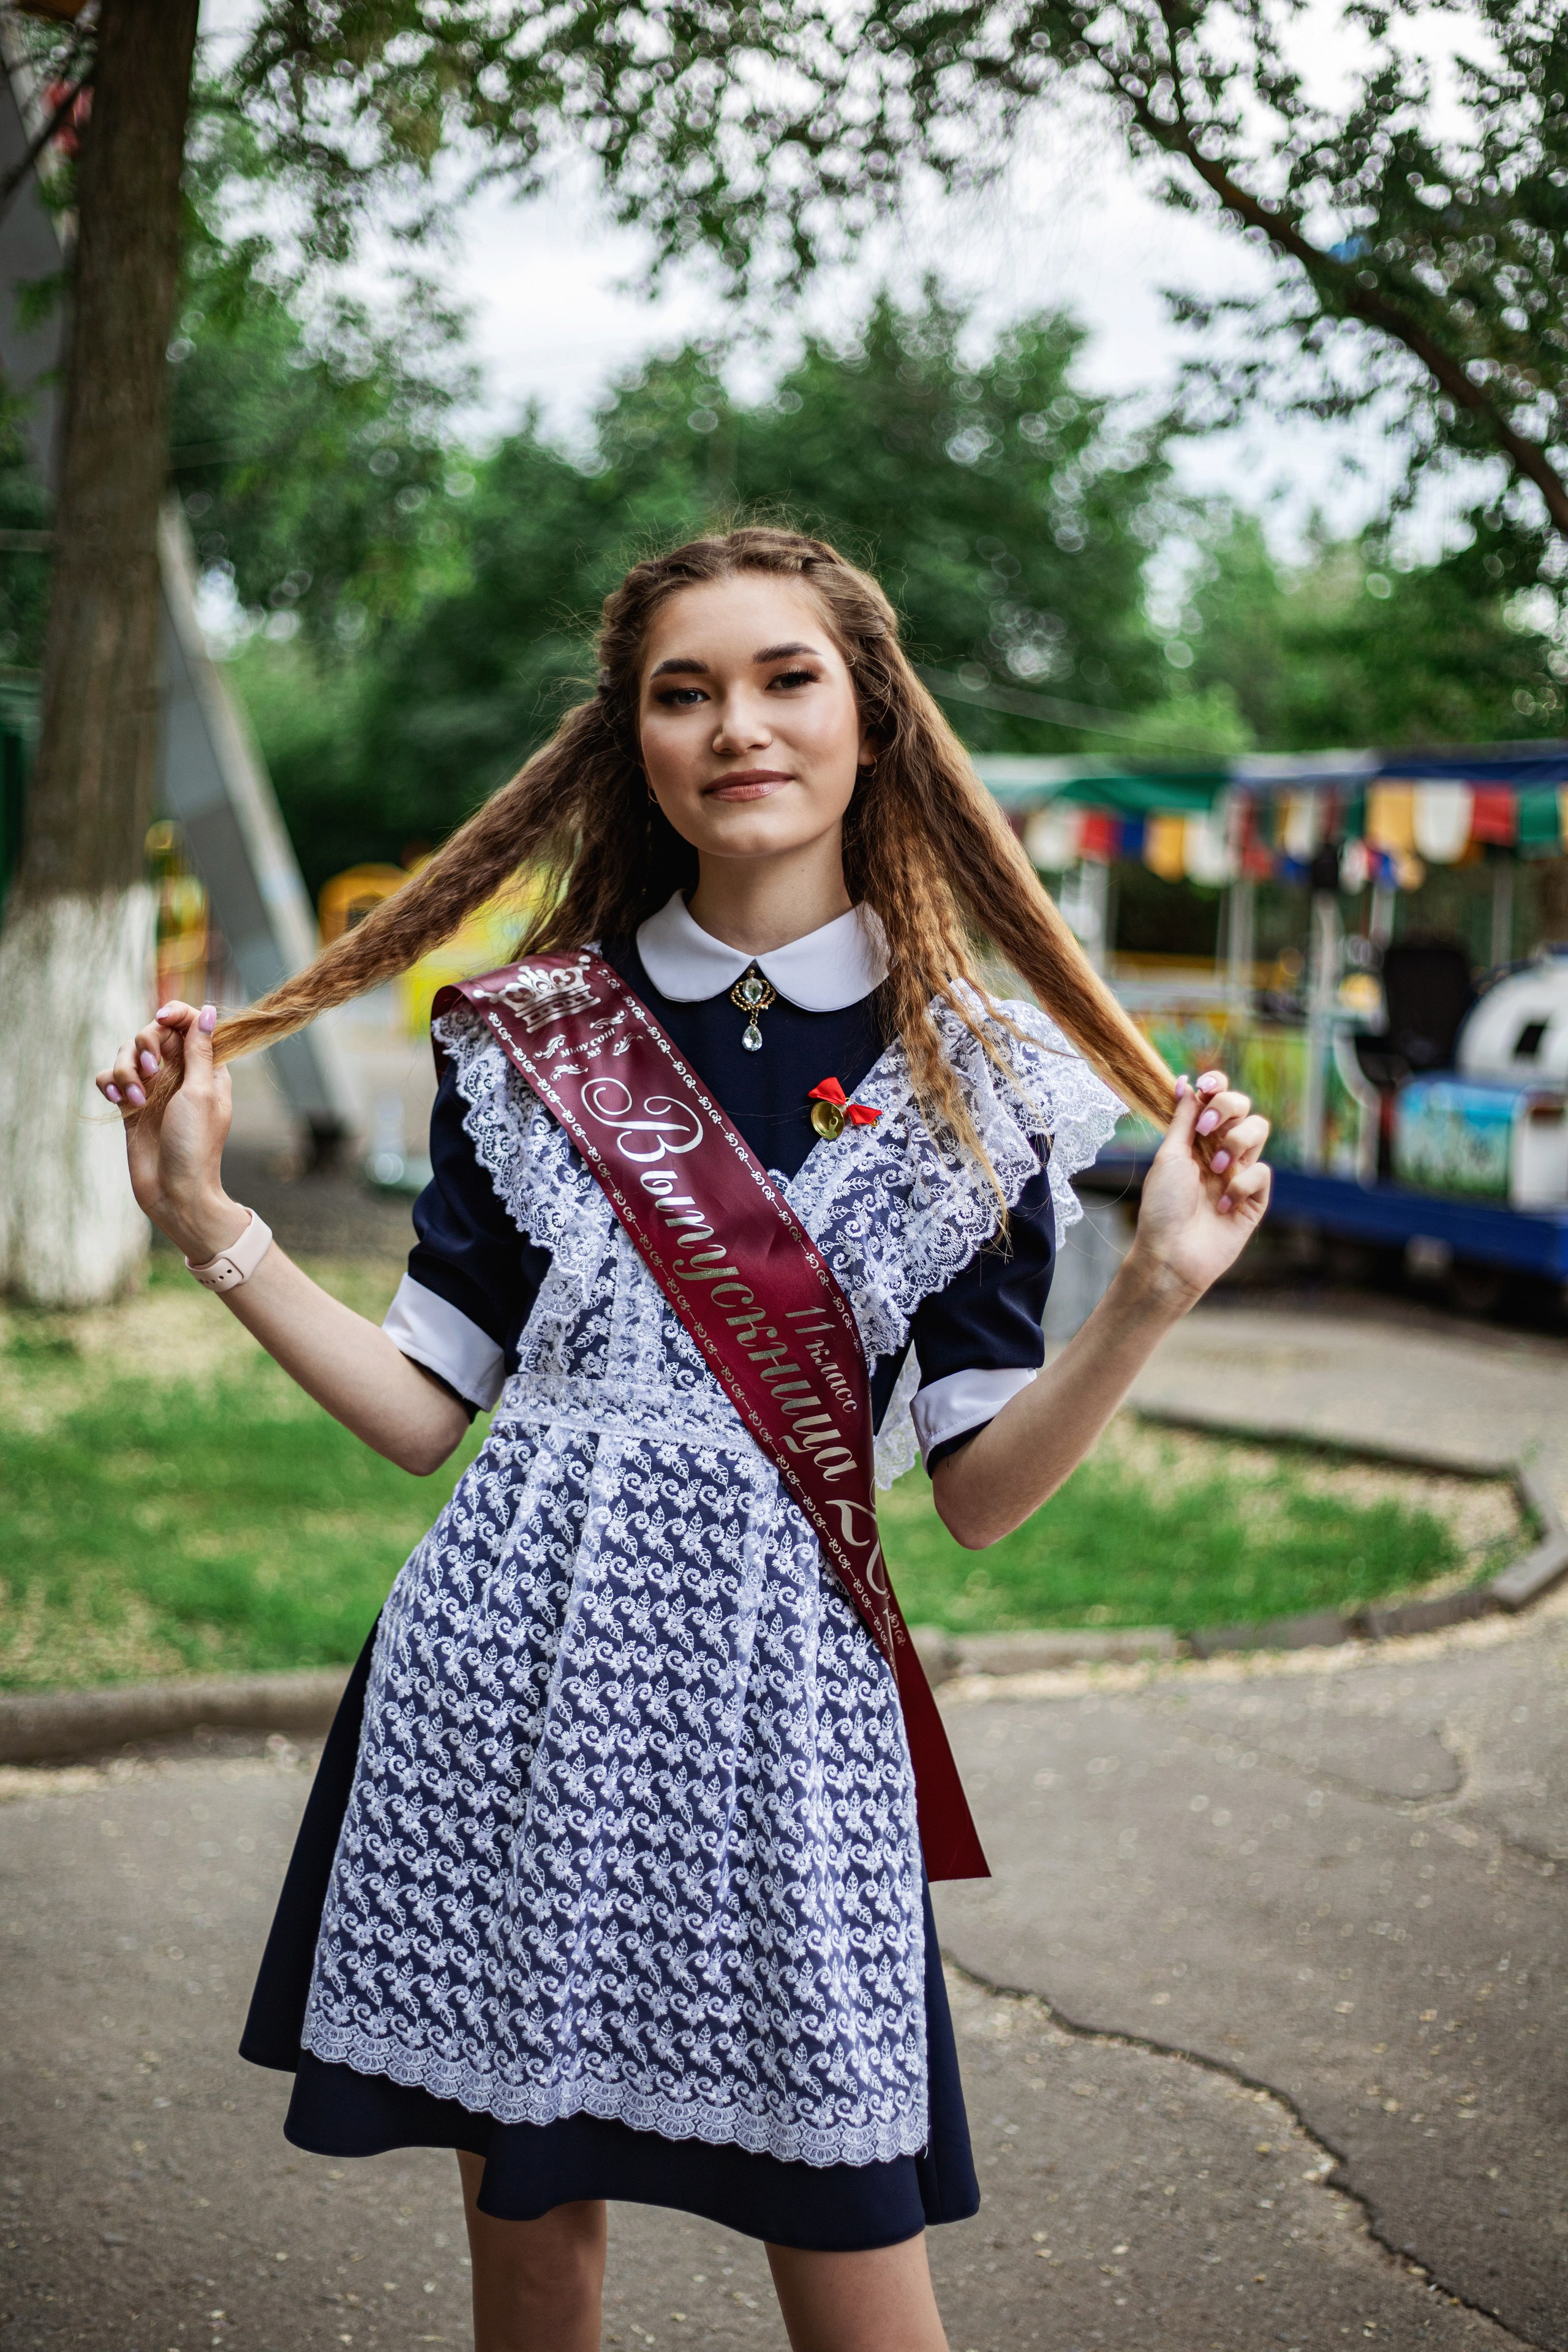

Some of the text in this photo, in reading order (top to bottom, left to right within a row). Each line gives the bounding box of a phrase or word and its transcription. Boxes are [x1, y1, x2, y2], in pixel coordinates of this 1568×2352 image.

[586, 1047, 601, 1060] №5
[590, 1028, 616, 1047] СОШ
[581, 1077, 858, 1481] Выпускница
[785, 1306, 858, 1412] 11 класс
